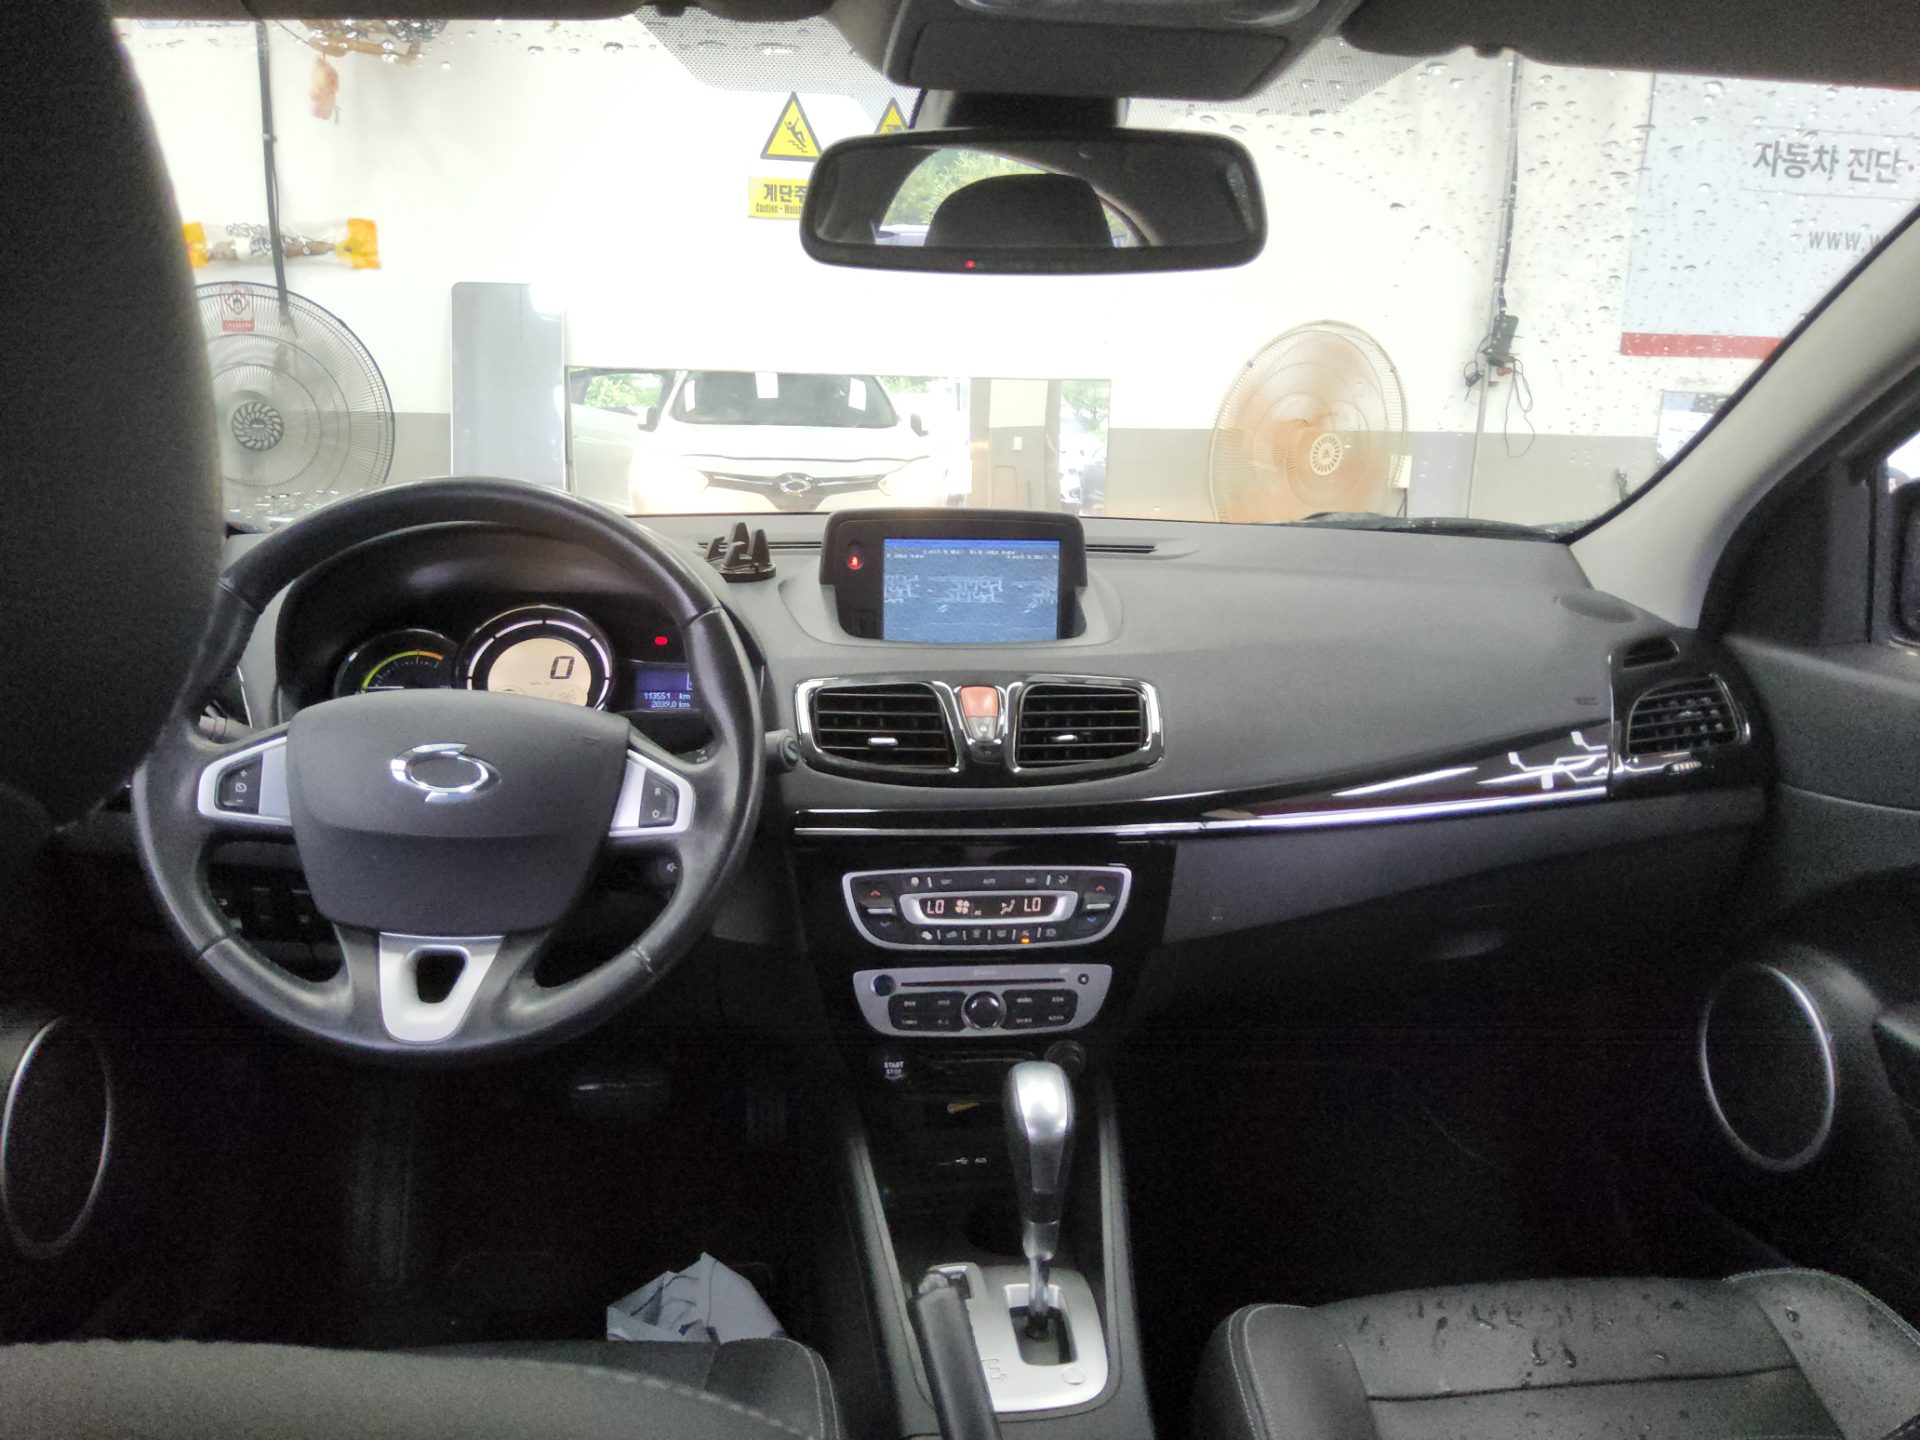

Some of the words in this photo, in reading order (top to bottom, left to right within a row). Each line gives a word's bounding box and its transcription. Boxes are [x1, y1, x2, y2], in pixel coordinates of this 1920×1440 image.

[1753, 140, 1839, 181] 자동차
[549, 655, 575, 680] 0
[678, 692, 691, 700] km
[678, 700, 691, 708] km
[884, 1060, 905, 1069] START
